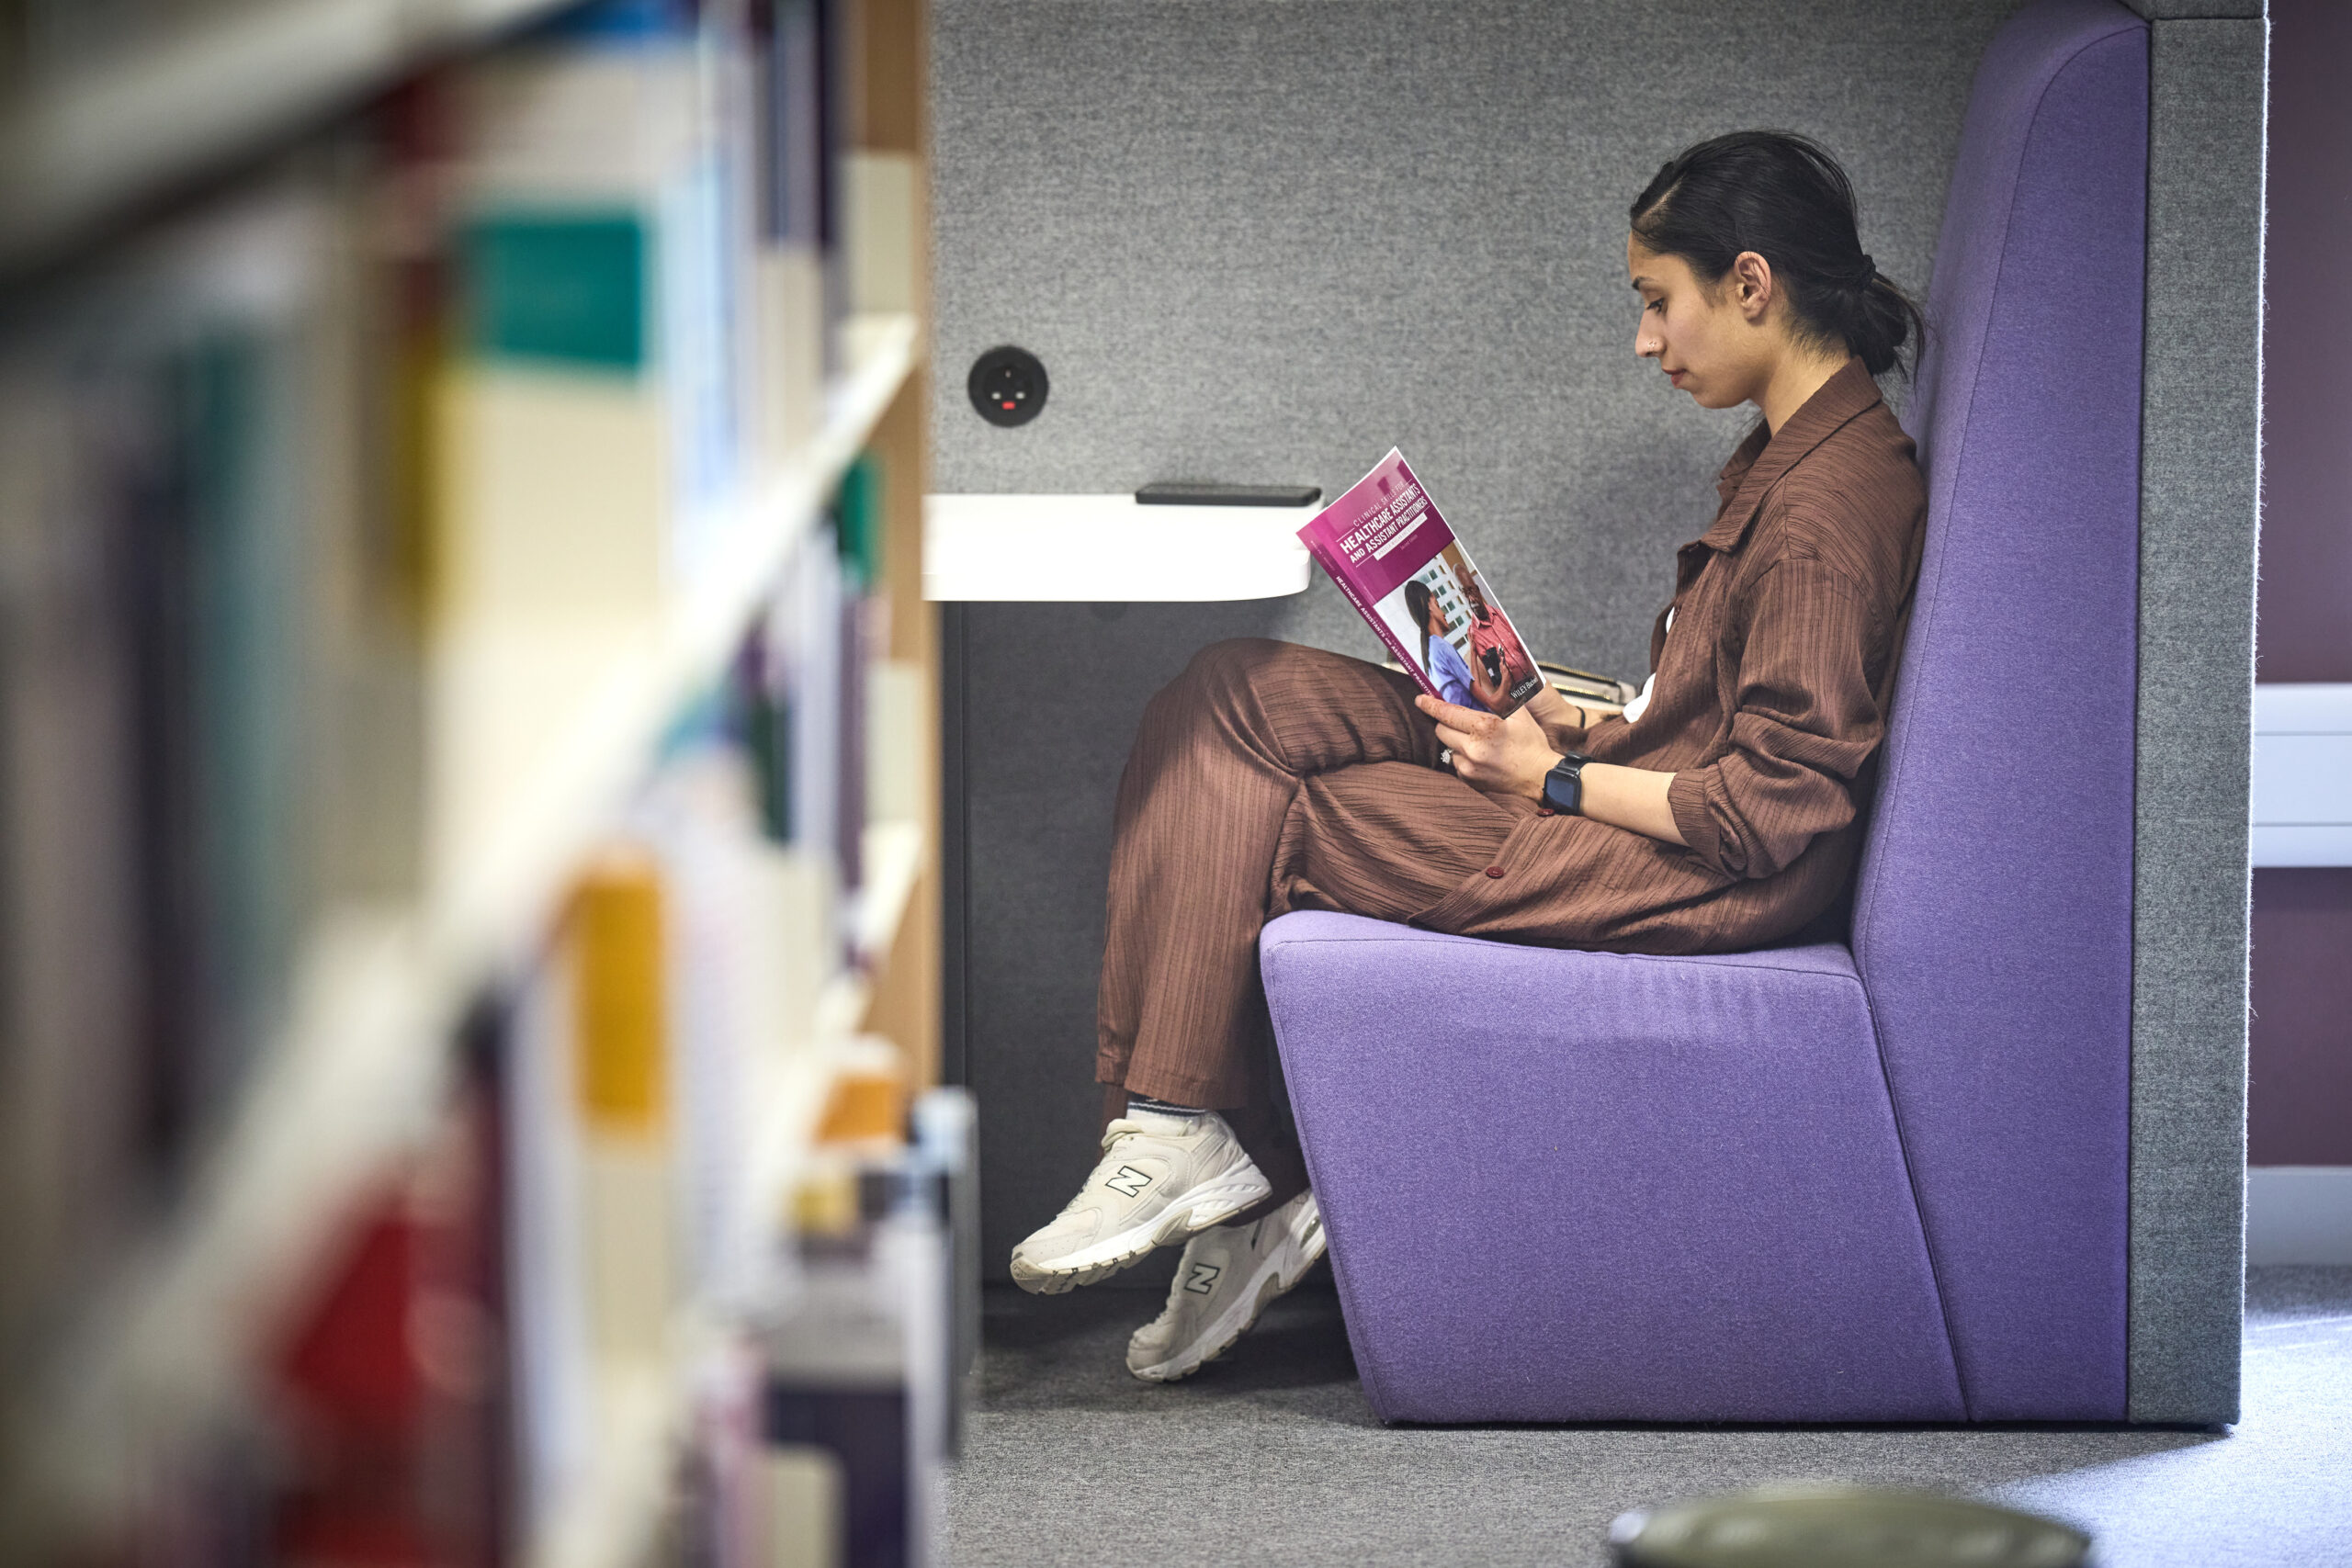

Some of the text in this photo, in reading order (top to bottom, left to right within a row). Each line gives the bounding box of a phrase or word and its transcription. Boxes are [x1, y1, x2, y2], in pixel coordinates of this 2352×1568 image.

[1340, 507, 1394, 554] HEALTHCARE
[1389, 483, 1421, 516] ASSISTANTS
[1352, 480, 1405, 527] CLINICAL SKILLS FOR
[1350, 547, 1365, 563] AND
[1364, 521, 1399, 553] ASSISTANT
[1395, 496, 1429, 528] PRACTITIONERS
[1336, 575, 1363, 607] HEALTHCARE
[1361, 607, 1385, 637] ASSISTANTS
[1391, 646, 1415, 672] ASSISTANT
[1510, 684, 1528, 699] WILEY
[1105, 1166, 1152, 1198] N
[1183, 1262, 1220, 1295] N
